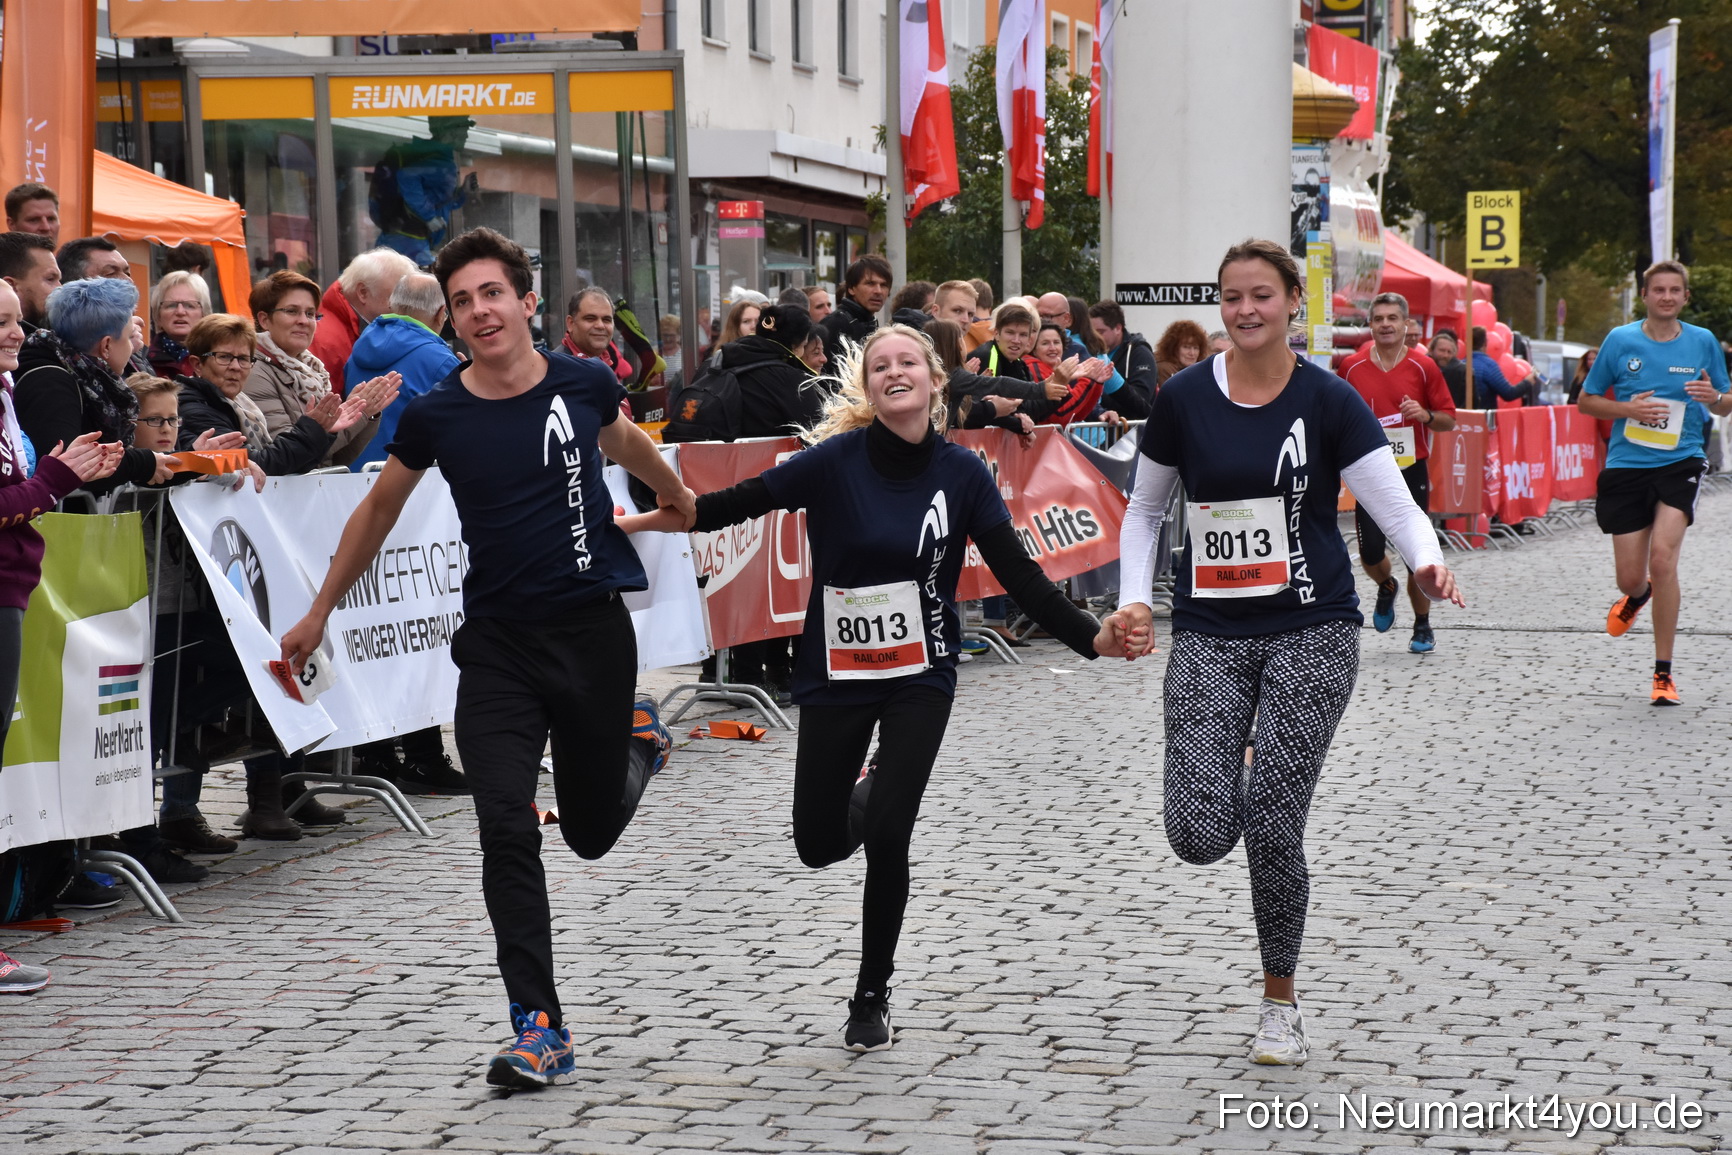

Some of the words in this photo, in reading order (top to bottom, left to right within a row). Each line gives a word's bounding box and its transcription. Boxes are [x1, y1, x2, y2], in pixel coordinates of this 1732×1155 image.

[351, 83, 537, 109] RUNMARKT.DE
[1474, 195, 1514, 209] Block
[1481, 215, 1506, 251] B
[1116, 286, 1221, 303] www.MINI-Pa
[562, 447, 593, 573] RAIL.ONE
[1033, 505, 1100, 552] Hits
[1204, 528, 1273, 561] 8013
[1289, 475, 1317, 605] RAIL.ONE
[1216, 568, 1262, 581] RAIL.ONE
[341, 623, 399, 664] WENIGER
[837, 612, 908, 644] 8013
[853, 651, 899, 664] RAIL.ONE
